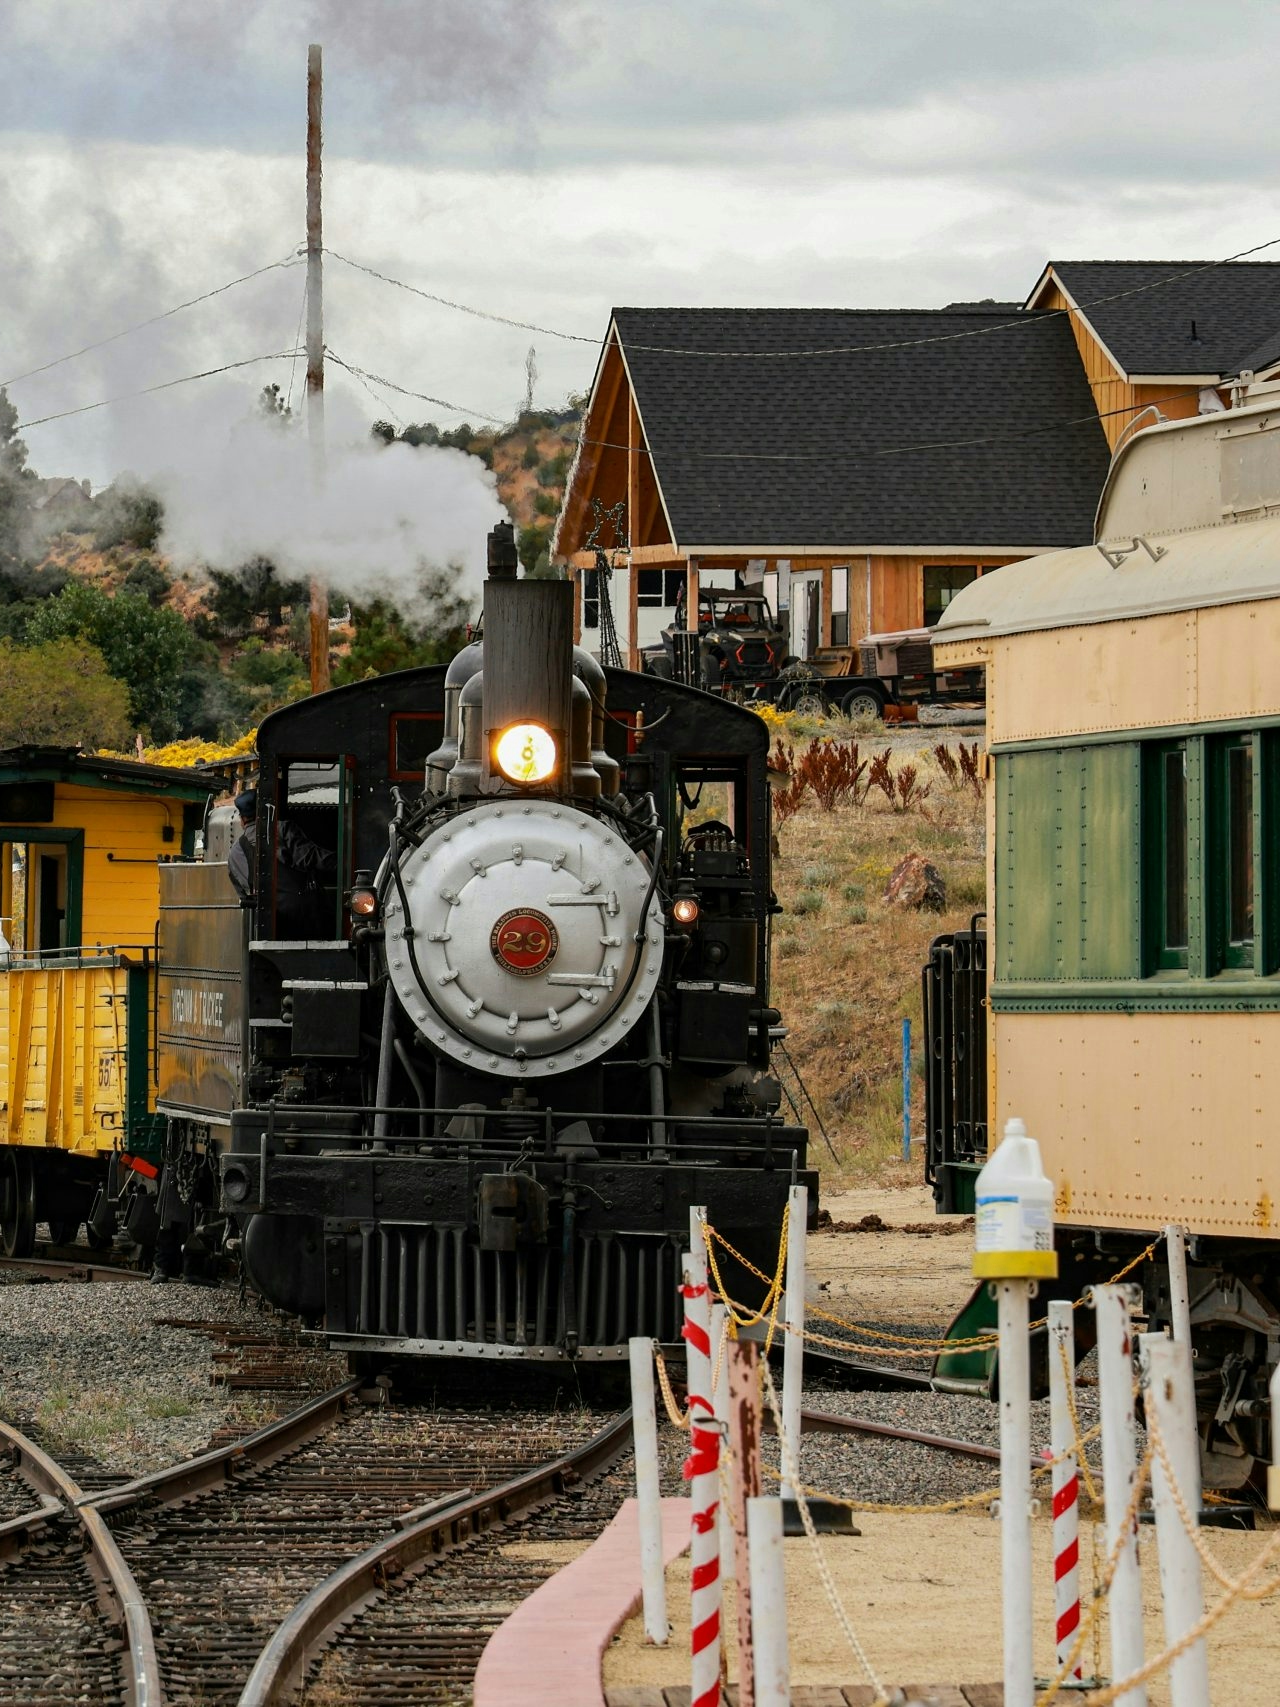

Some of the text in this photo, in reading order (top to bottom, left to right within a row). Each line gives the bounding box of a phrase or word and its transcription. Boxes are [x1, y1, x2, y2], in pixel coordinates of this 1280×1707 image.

[494, 911, 518, 934] BALDWIN
[518, 909, 553, 929] LOCOMOTIVE
[503, 931, 546, 953] 29
